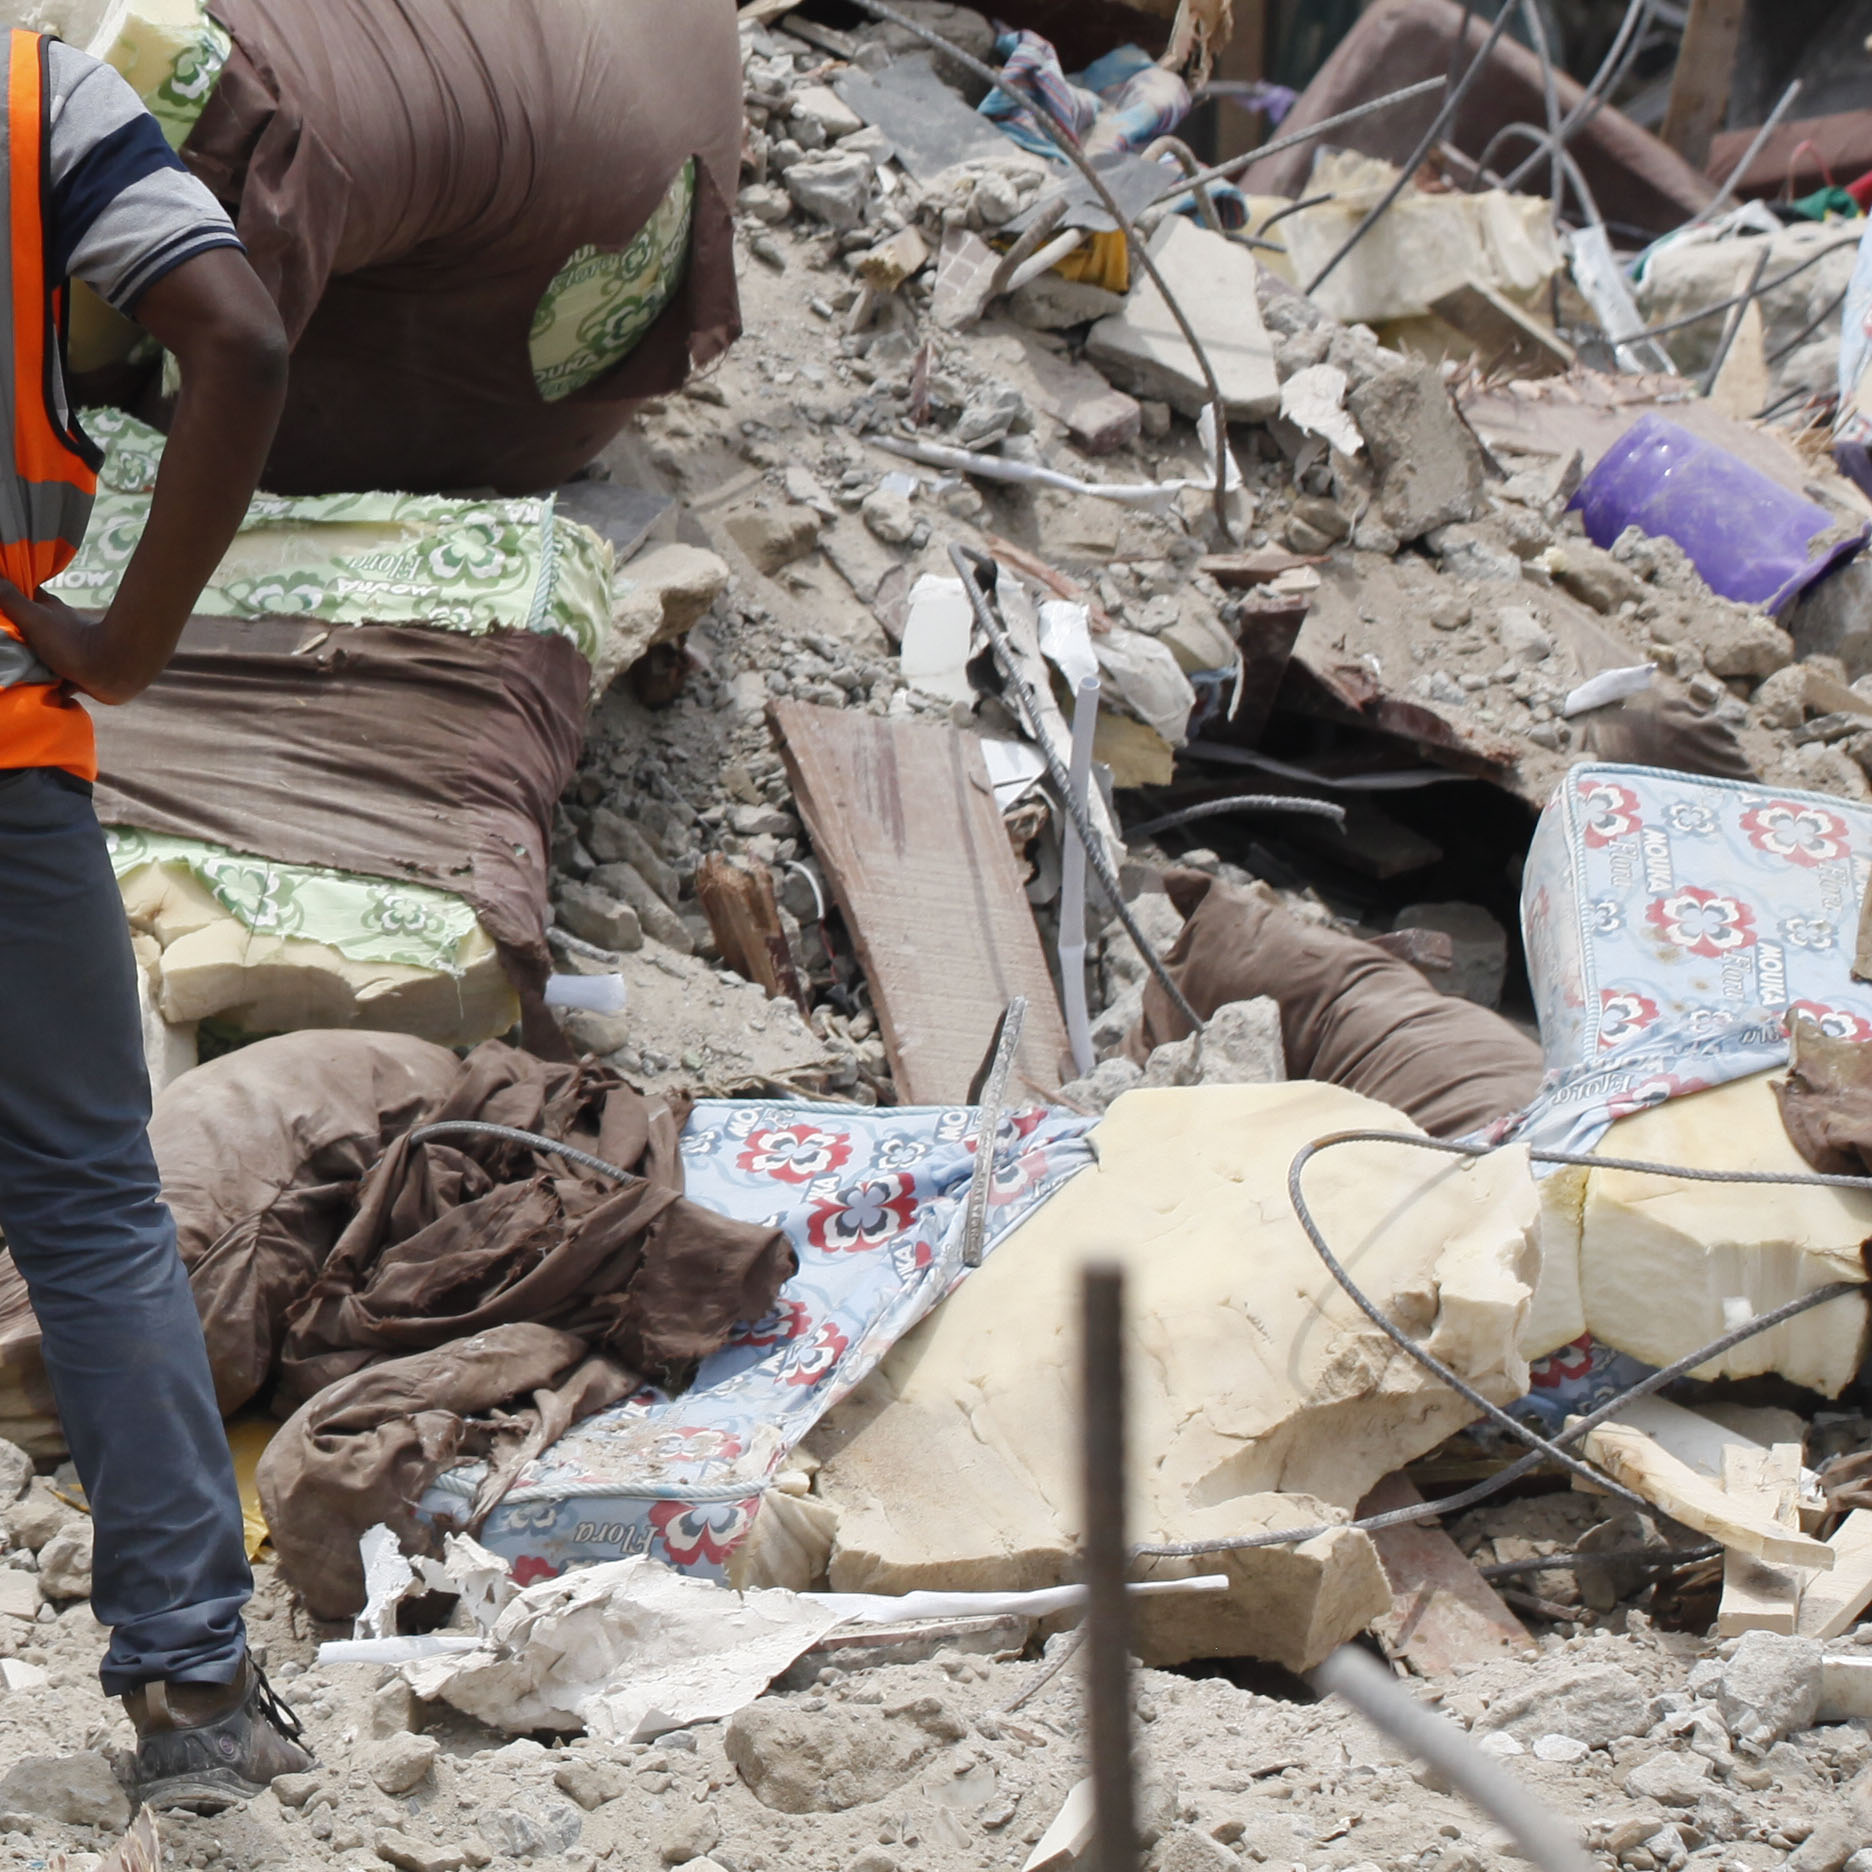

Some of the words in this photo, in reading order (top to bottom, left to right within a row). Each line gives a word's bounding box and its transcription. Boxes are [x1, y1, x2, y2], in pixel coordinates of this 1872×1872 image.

[1642, 826, 1672, 895] MOUKA
[1721, 950, 1752, 1001] Flora
[1757, 940, 1787, 1007] MOUKA
[574, 1520, 660, 1555] Flora
